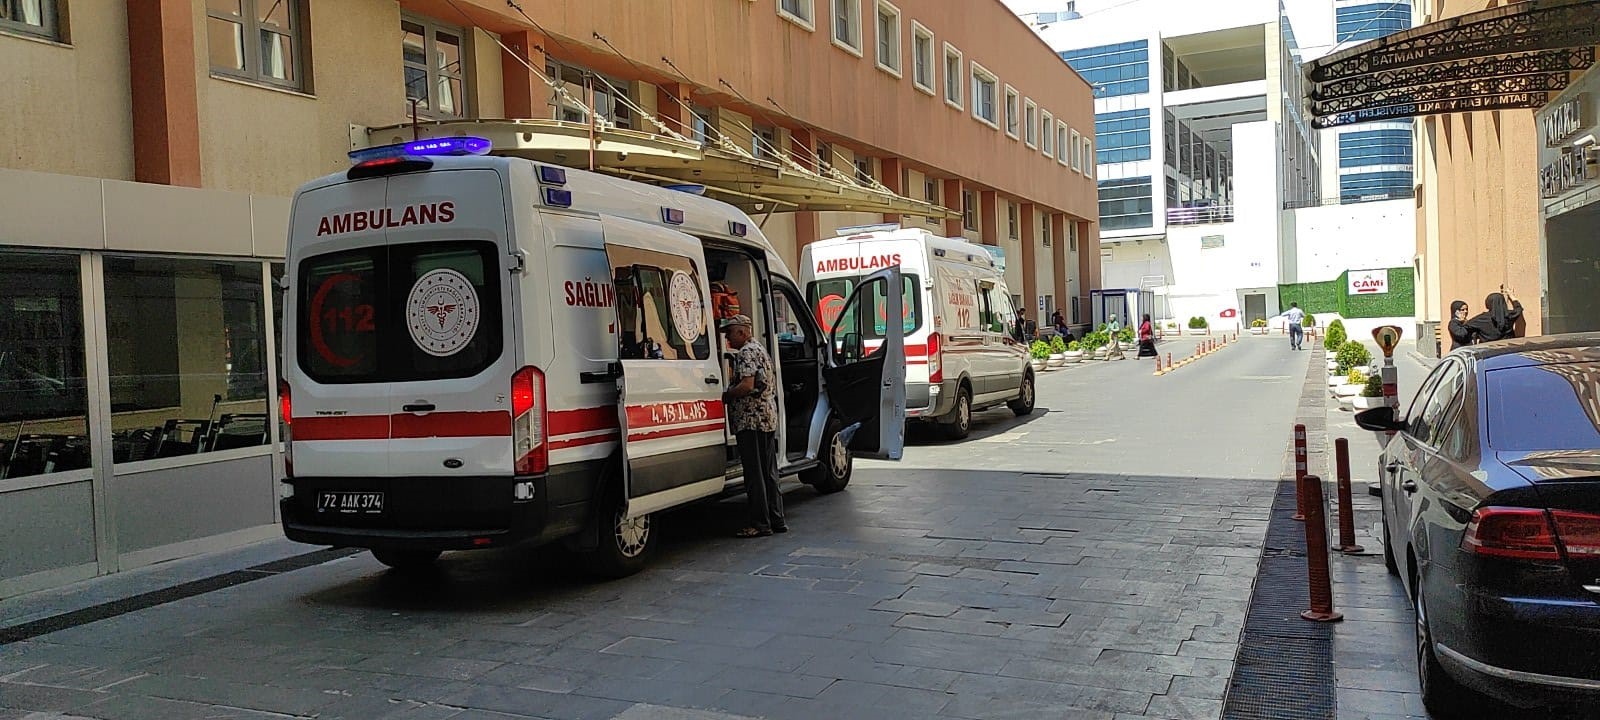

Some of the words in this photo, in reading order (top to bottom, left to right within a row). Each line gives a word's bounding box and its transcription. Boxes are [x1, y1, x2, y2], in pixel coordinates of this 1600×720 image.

[1372, 50, 1425, 66] BATMAN
[316, 202, 455, 237] AMBULANS
[816, 253, 902, 273] AMBULANS
[324, 304, 375, 333] 112
[957, 308, 970, 328] 112
[323, 494, 336, 507] 72
[341, 494, 360, 508] AAK
[361, 494, 381, 508] 374
